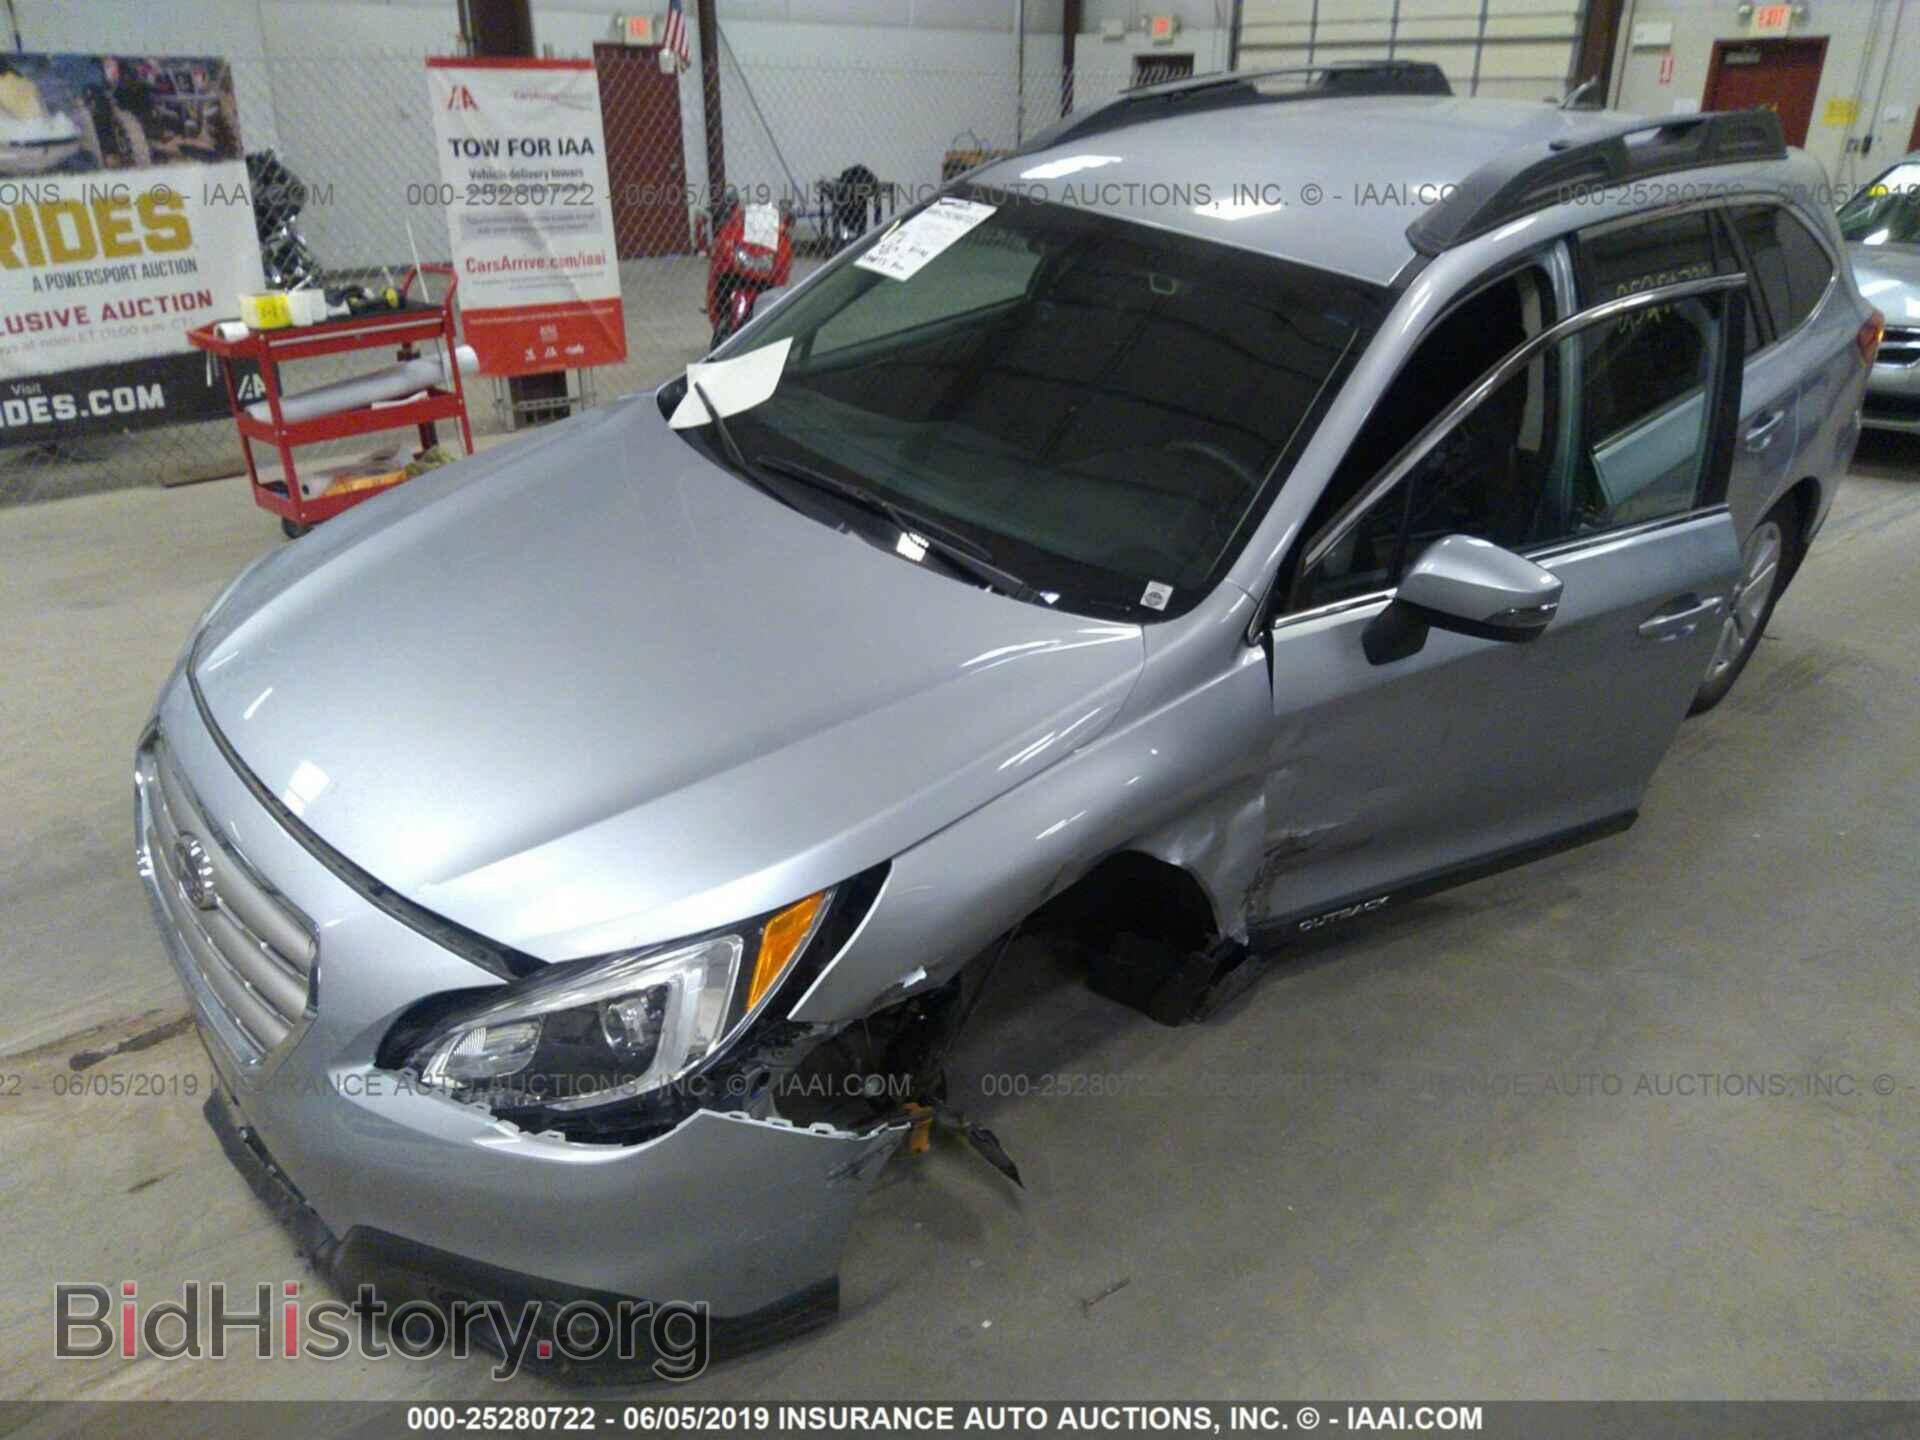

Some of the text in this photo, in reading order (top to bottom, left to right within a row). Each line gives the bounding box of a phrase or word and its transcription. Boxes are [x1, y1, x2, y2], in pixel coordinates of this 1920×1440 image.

[448, 137, 595, 158] TOW FOR IAA
[32, 256, 199, 293] A POWERSPORT AUCTION
[0, 289, 214, 337] USIVE AUCTION
